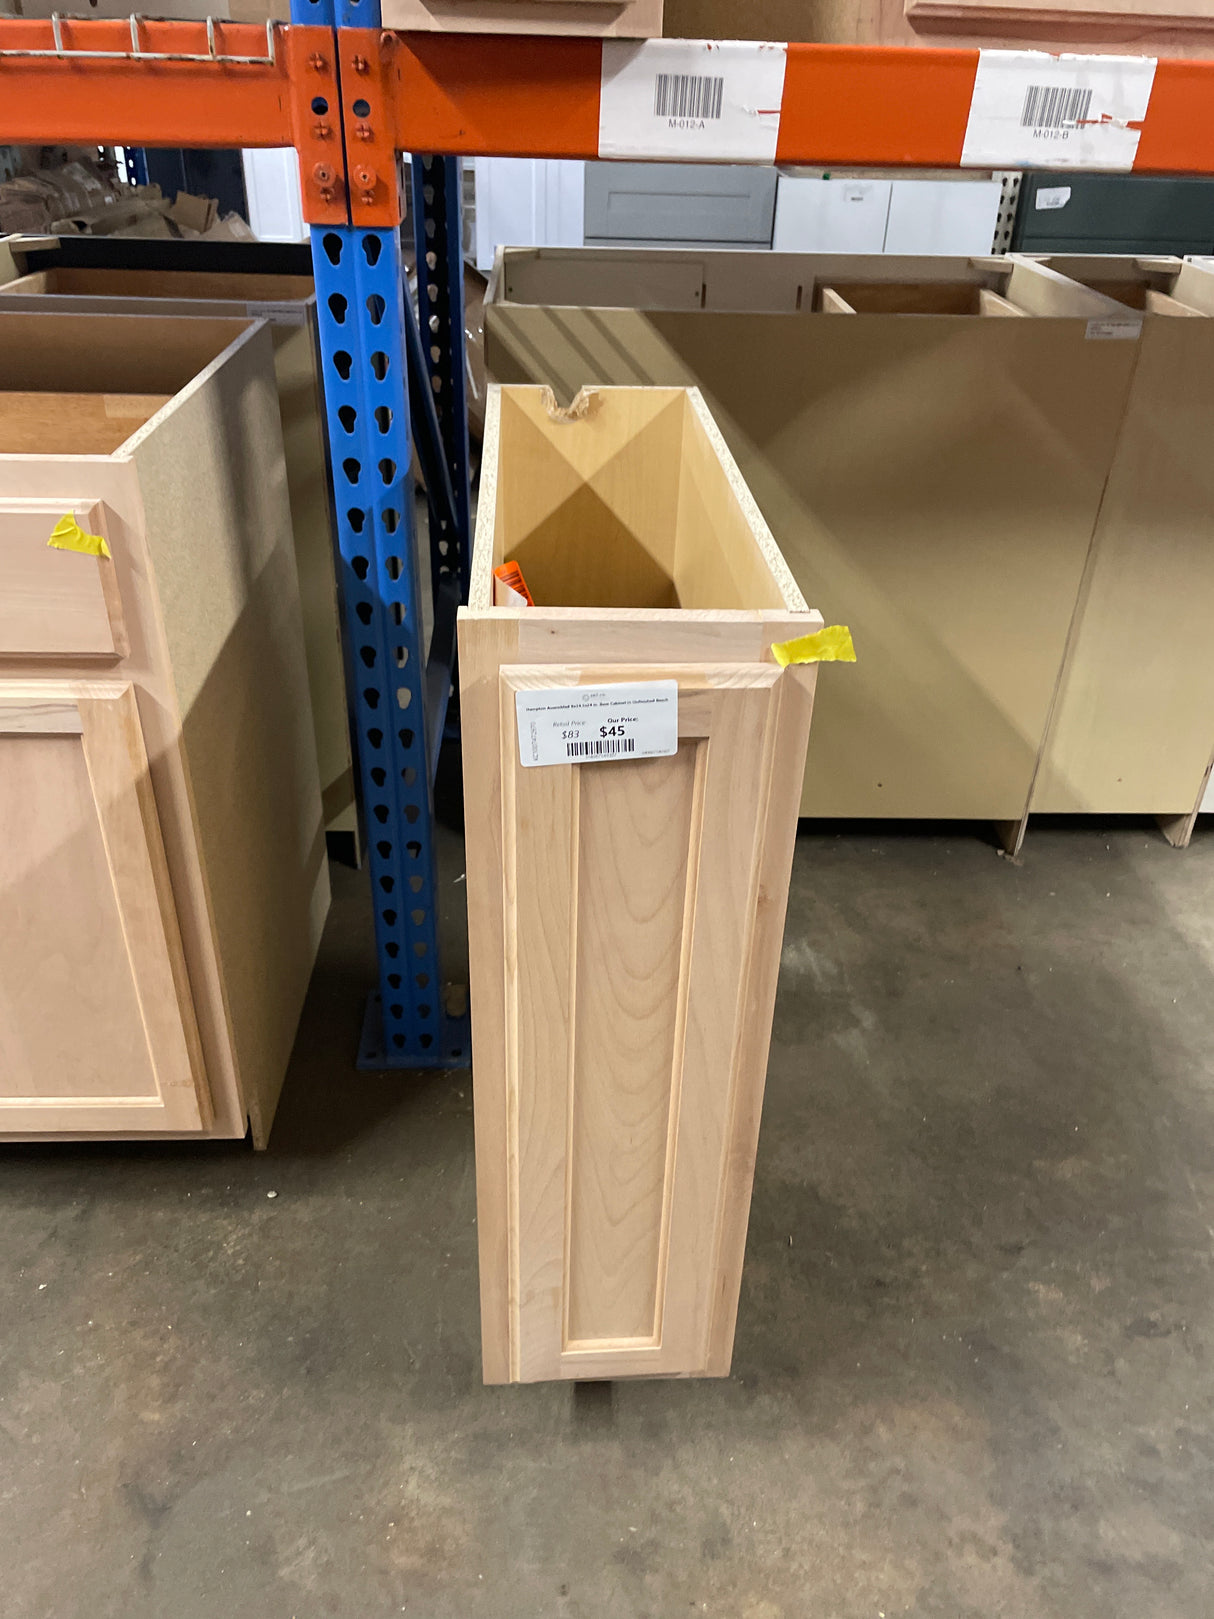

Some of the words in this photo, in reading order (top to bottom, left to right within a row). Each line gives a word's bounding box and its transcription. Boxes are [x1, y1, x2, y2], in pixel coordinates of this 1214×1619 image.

[668, 118, 705, 130] M-012-A
[1033, 129, 1069, 140] M-012-B
[562, 730, 580, 739] $83
[599, 725, 625, 738] $45
